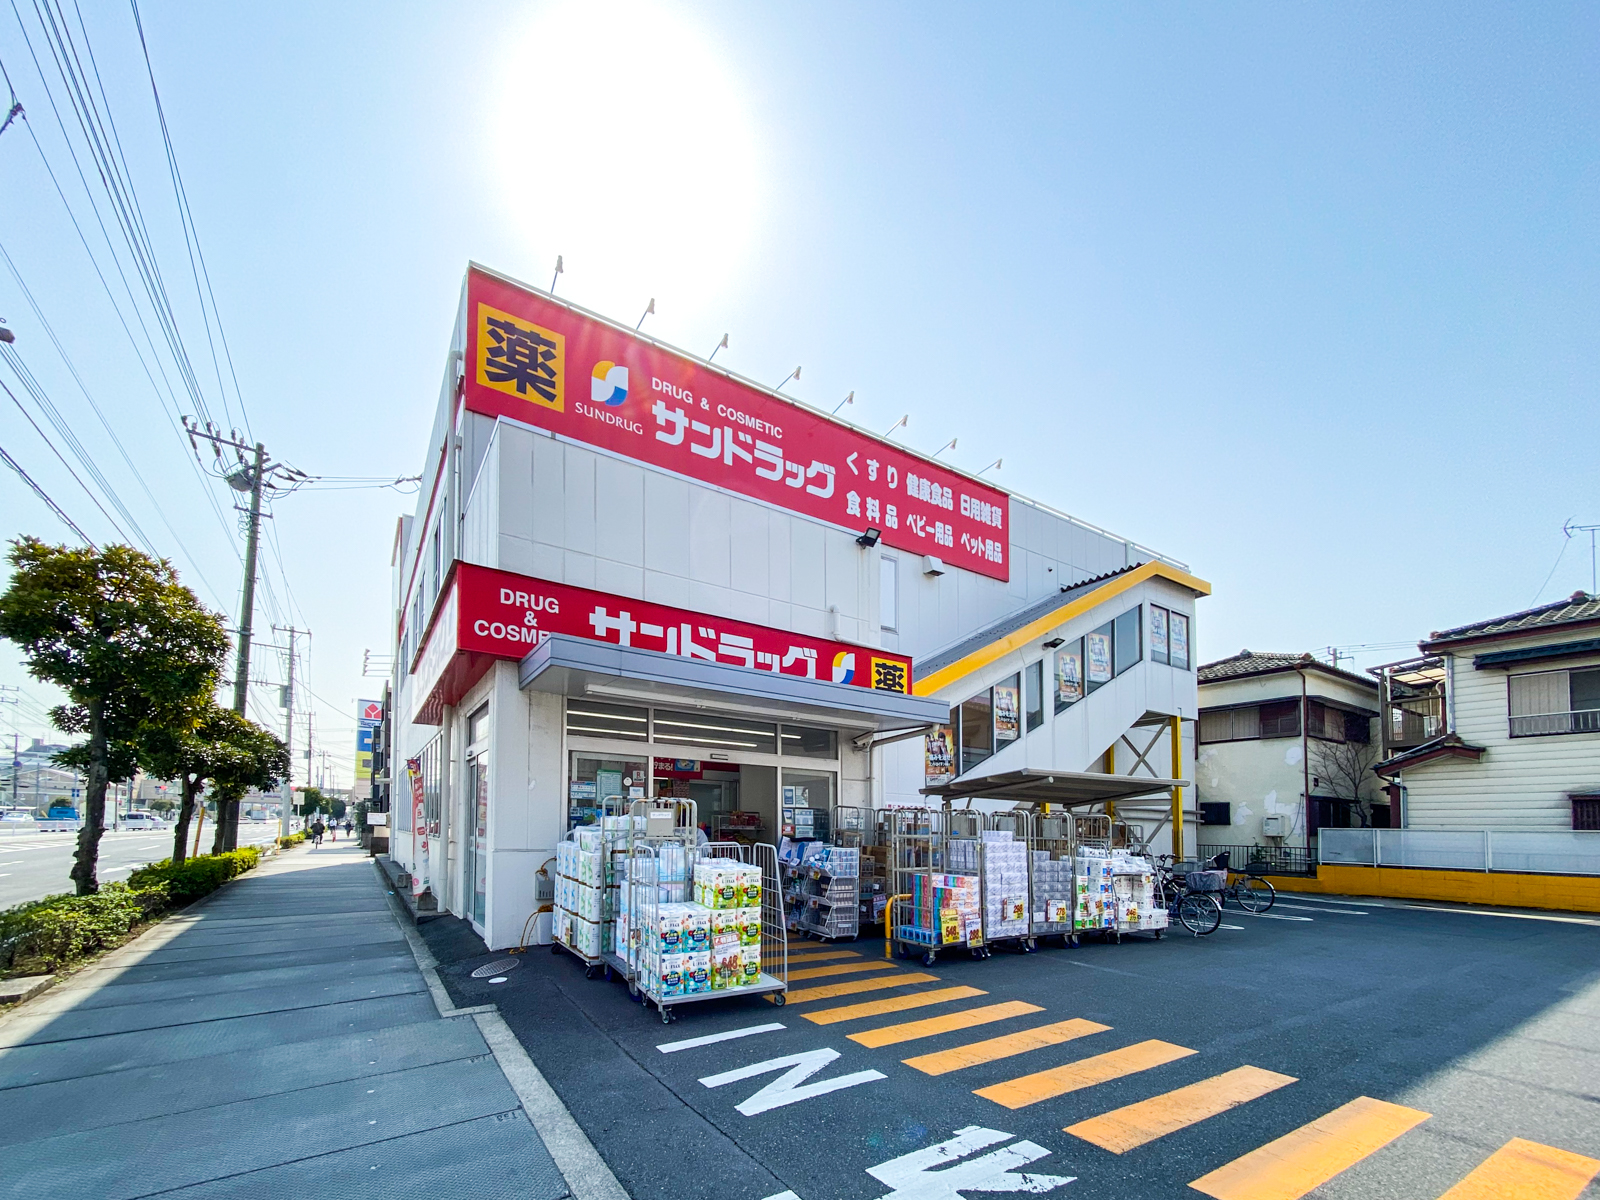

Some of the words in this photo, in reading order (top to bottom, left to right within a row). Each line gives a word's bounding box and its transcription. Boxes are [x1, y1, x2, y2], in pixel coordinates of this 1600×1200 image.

[484, 316, 557, 403] 薬
[575, 402, 643, 435] SUNDRUG
[651, 376, 693, 405] DRUG
[700, 397, 710, 411] &
[717, 404, 783, 439] COSMETIC
[652, 399, 836, 499] サンドラッグ
[846, 452, 898, 489] くすり
[906, 472, 953, 511] 健康食品
[960, 494, 1002, 529] 日用雑貨
[846, 490, 898, 529] 食料品
[906, 514, 953, 548] ベビー用品
[500, 588, 560, 614] DRUG
[523, 610, 538, 628] &
